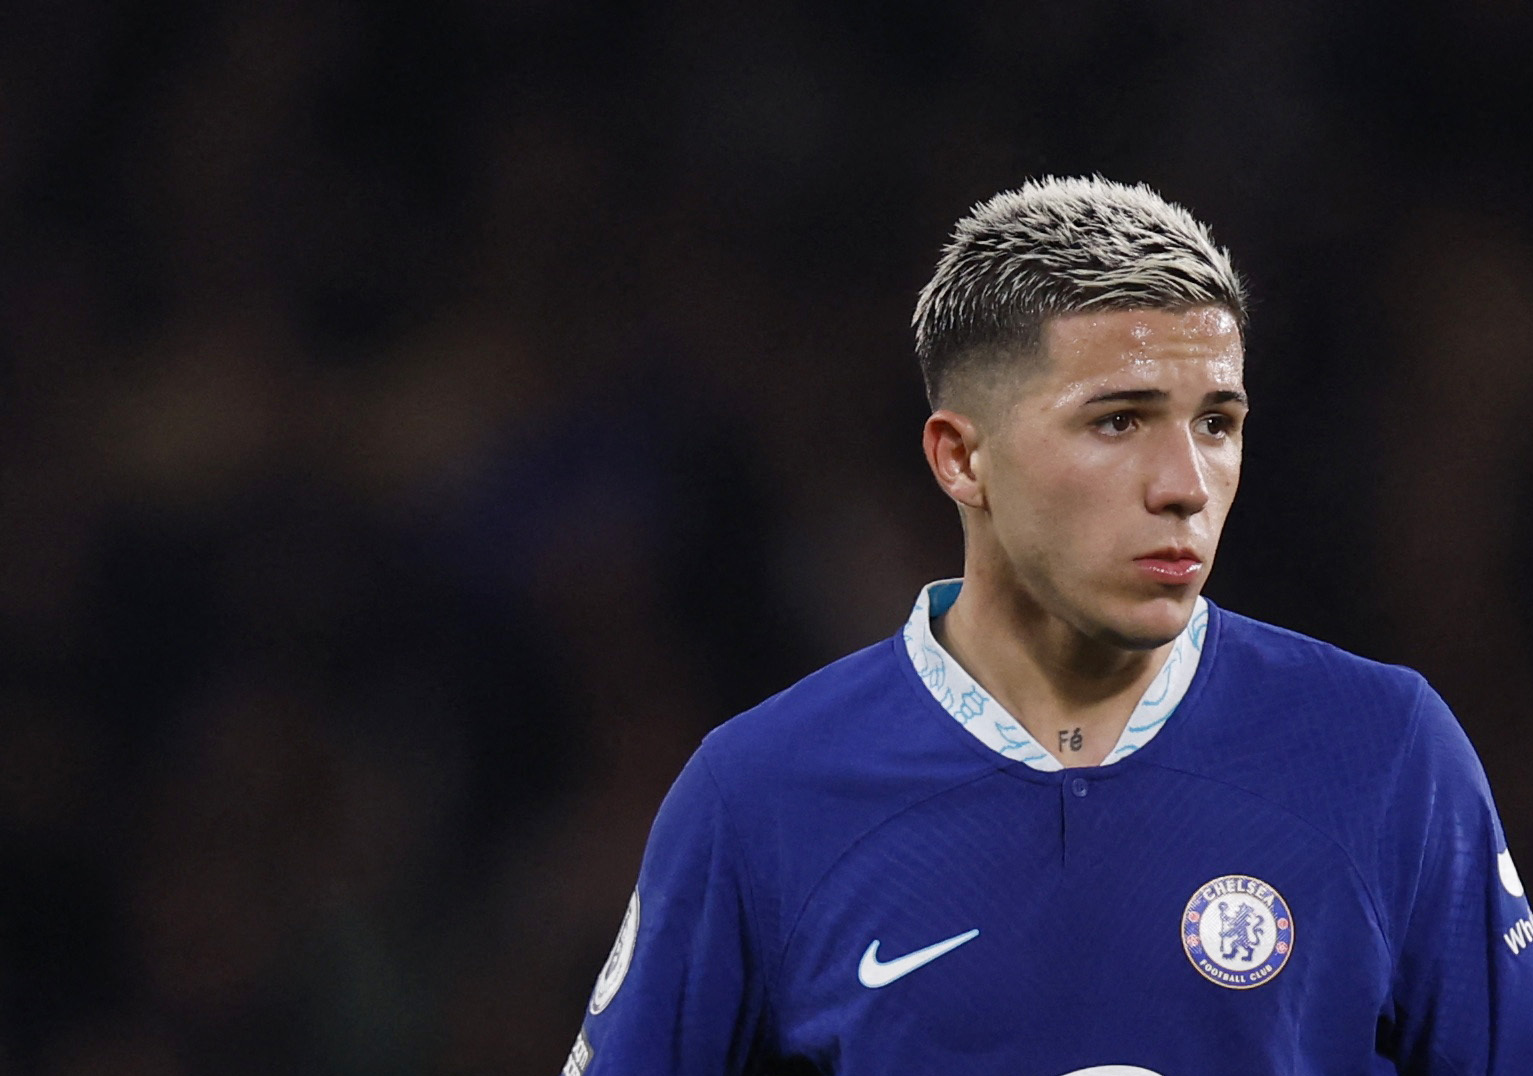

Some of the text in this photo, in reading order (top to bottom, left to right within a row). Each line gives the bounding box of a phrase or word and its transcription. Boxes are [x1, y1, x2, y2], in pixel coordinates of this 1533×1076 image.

[1058, 727, 1083, 753] Fé
[1202, 879, 1275, 908] CHELSEA
[1200, 959, 1273, 983] FOOTBALL CLUB
